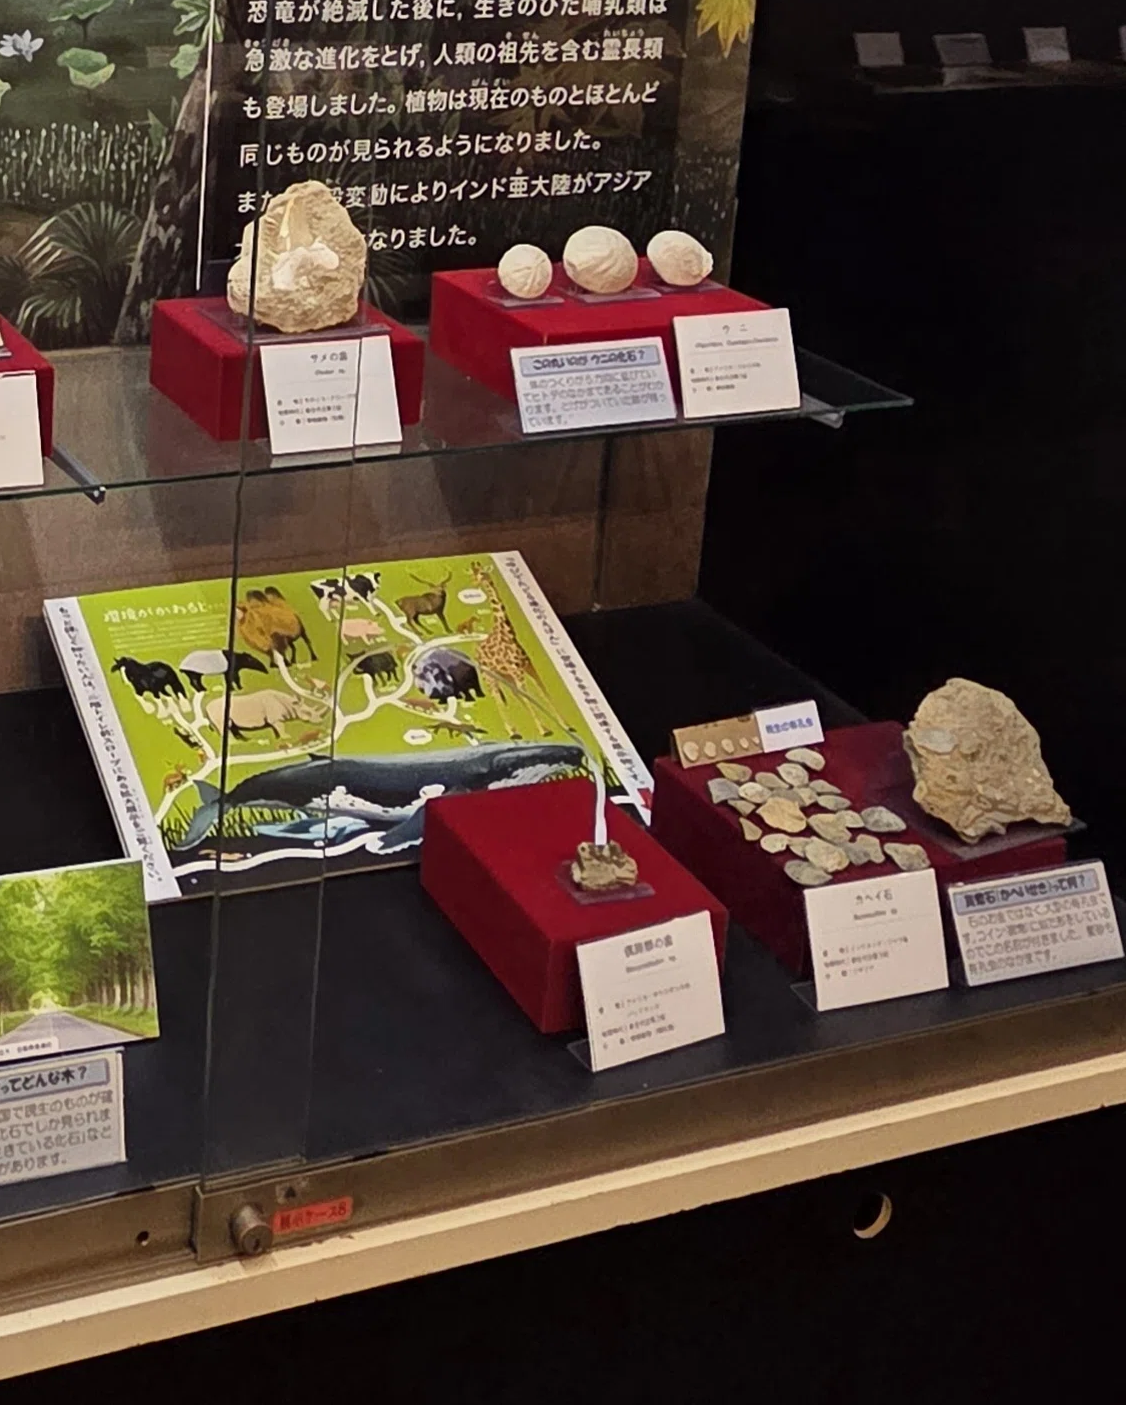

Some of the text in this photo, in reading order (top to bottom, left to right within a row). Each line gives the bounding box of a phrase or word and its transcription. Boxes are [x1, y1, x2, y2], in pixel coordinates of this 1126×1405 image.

[242, 81, 658, 119] も登場しました。植物は現在のものとほとんど
[239, 130, 602, 167] 同じものが見られるようになりました。
